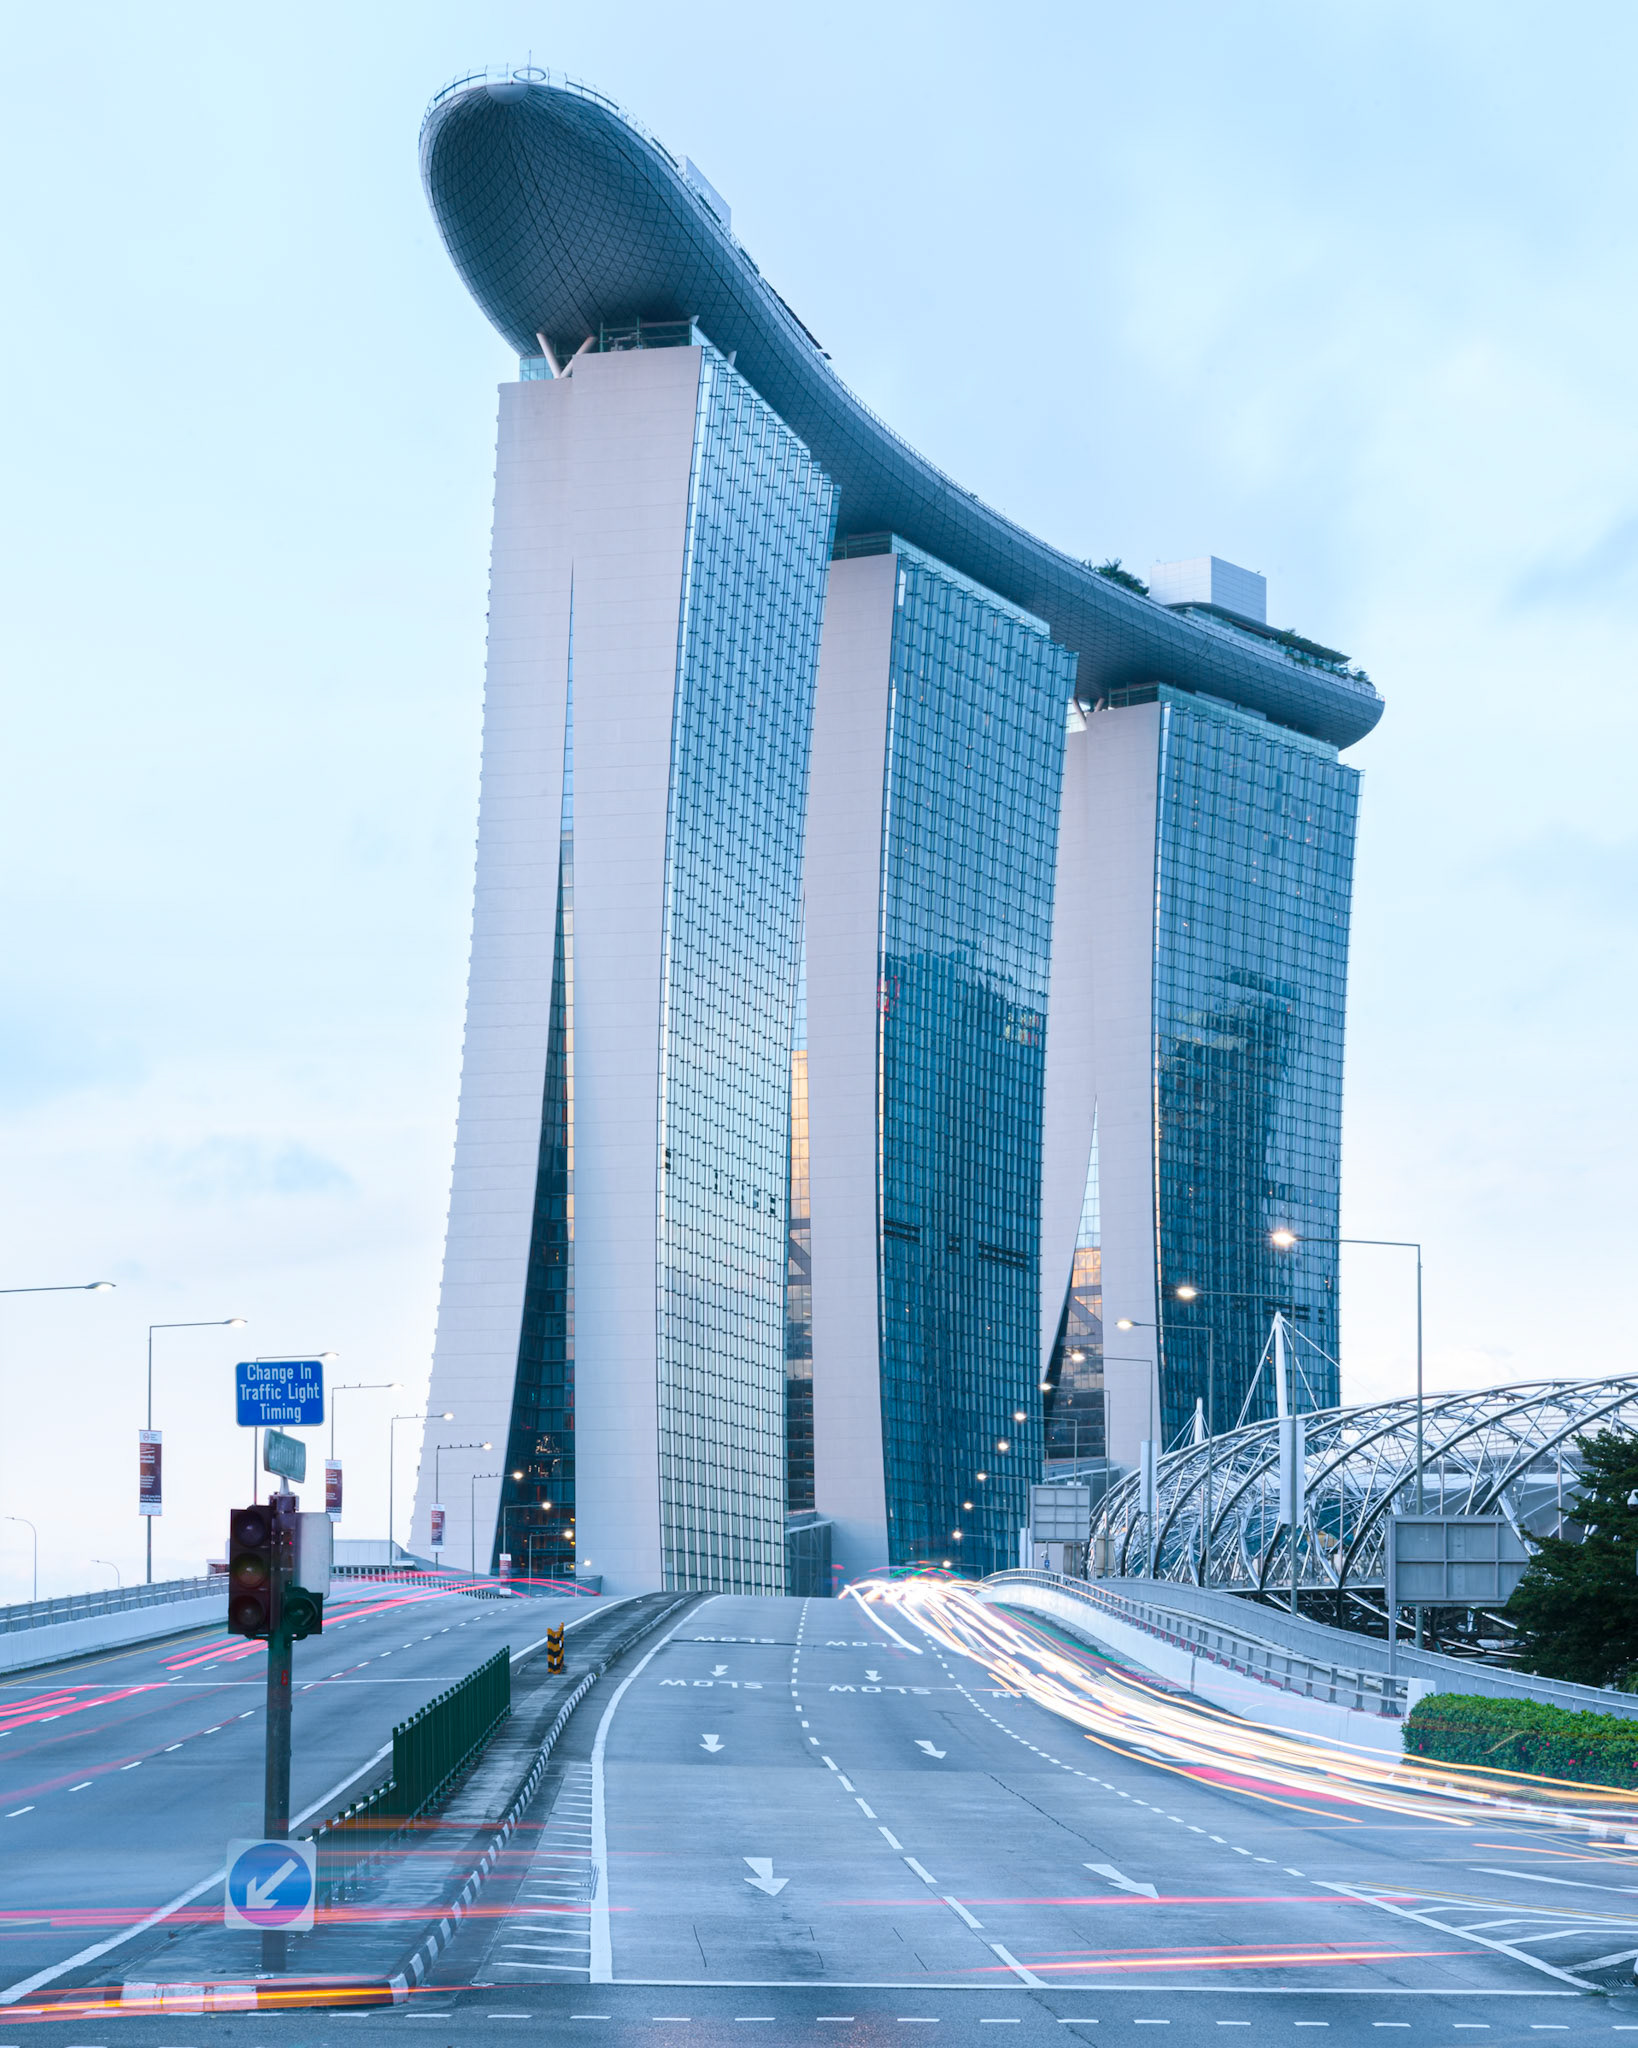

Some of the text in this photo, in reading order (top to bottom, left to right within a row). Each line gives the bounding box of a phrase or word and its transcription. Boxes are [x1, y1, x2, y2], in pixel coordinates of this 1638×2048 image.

[247, 1363, 312, 1384] Change In
[240, 1382, 320, 1403] Traffic Light
[260, 1403, 301, 1423] Timing
[694, 1636, 775, 1644] SLOW
[659, 1679, 763, 1689] SLOW
[828, 1685, 932, 1695] SLOW
